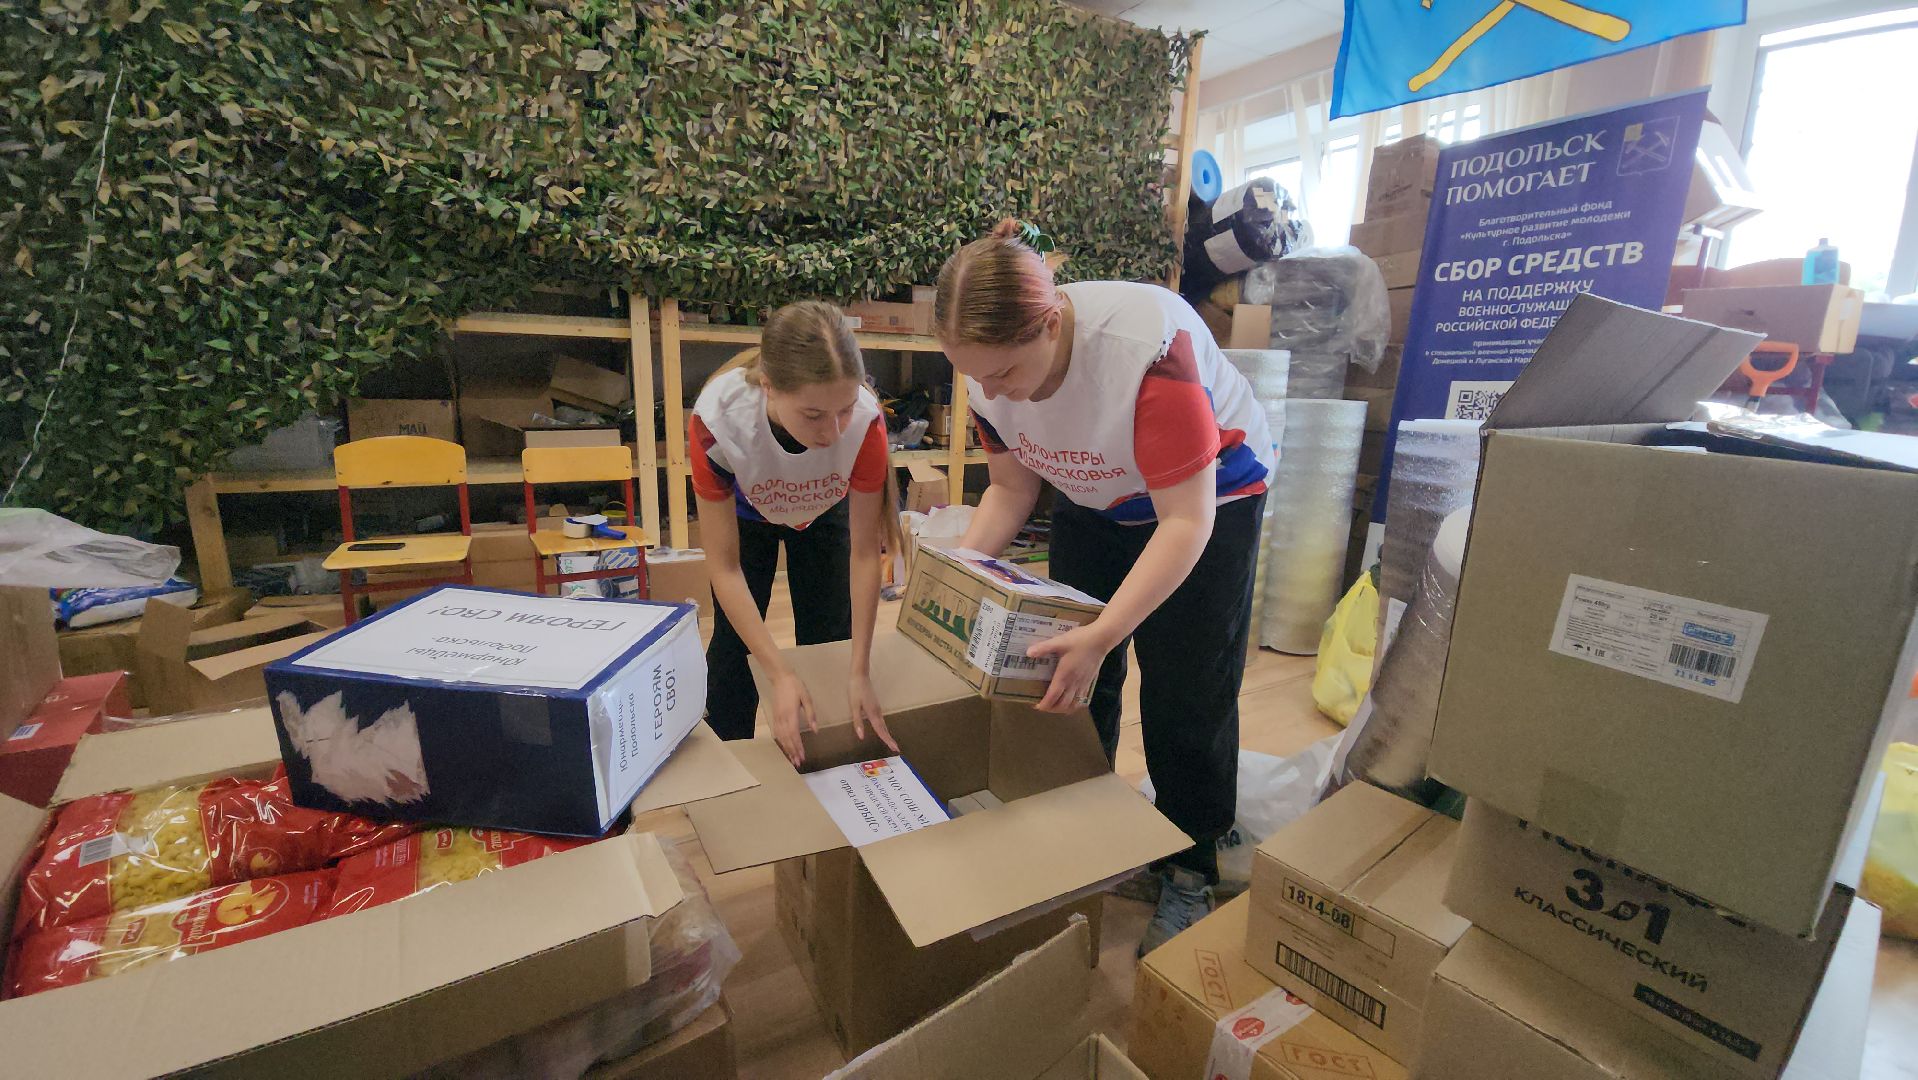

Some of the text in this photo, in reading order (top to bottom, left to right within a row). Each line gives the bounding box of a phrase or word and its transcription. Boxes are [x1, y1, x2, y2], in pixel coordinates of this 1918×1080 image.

[1451, 130, 1607, 179] ПОДОЛЬСК
[1446, 162, 1597, 206] ПОМОГАЕТ
[1479, 200, 1613, 227] Благотворительный фонд
[1521, 218, 1569, 234] развитие
[1570, 210, 1631, 225] молодежи
[1434, 241, 1645, 282] СБОР СРЕДСТВ
[1458, 299, 1574, 317] ВОЕННОСЛУЖАЩ
[1462, 279, 1594, 302] НА ПОДДЕРЖКУ
[1435, 315, 1562, 333] РОССИЙСКОЙ ФЕДЕ
[1018, 432, 1105, 465] ВОЛОНТЕРЫ
[749, 487, 844, 505] ОДМОСКОВ
[427, 606, 626, 631] ГЕРОЯМ СВО!
[405, 647, 527, 667] Юнармейцы
[652, 663, 663, 741] ГЕРОЯМ
[665, 668, 676, 712] СВО!
[618, 700, 628, 773] Юнармейц
[1288, 884, 1351, 929] 1814-08
[1565, 867, 1606, 911] 3
[1643, 902, 1671, 945] 1
[1513, 886, 1708, 993] КЛАССИЧЕСКИЙ
